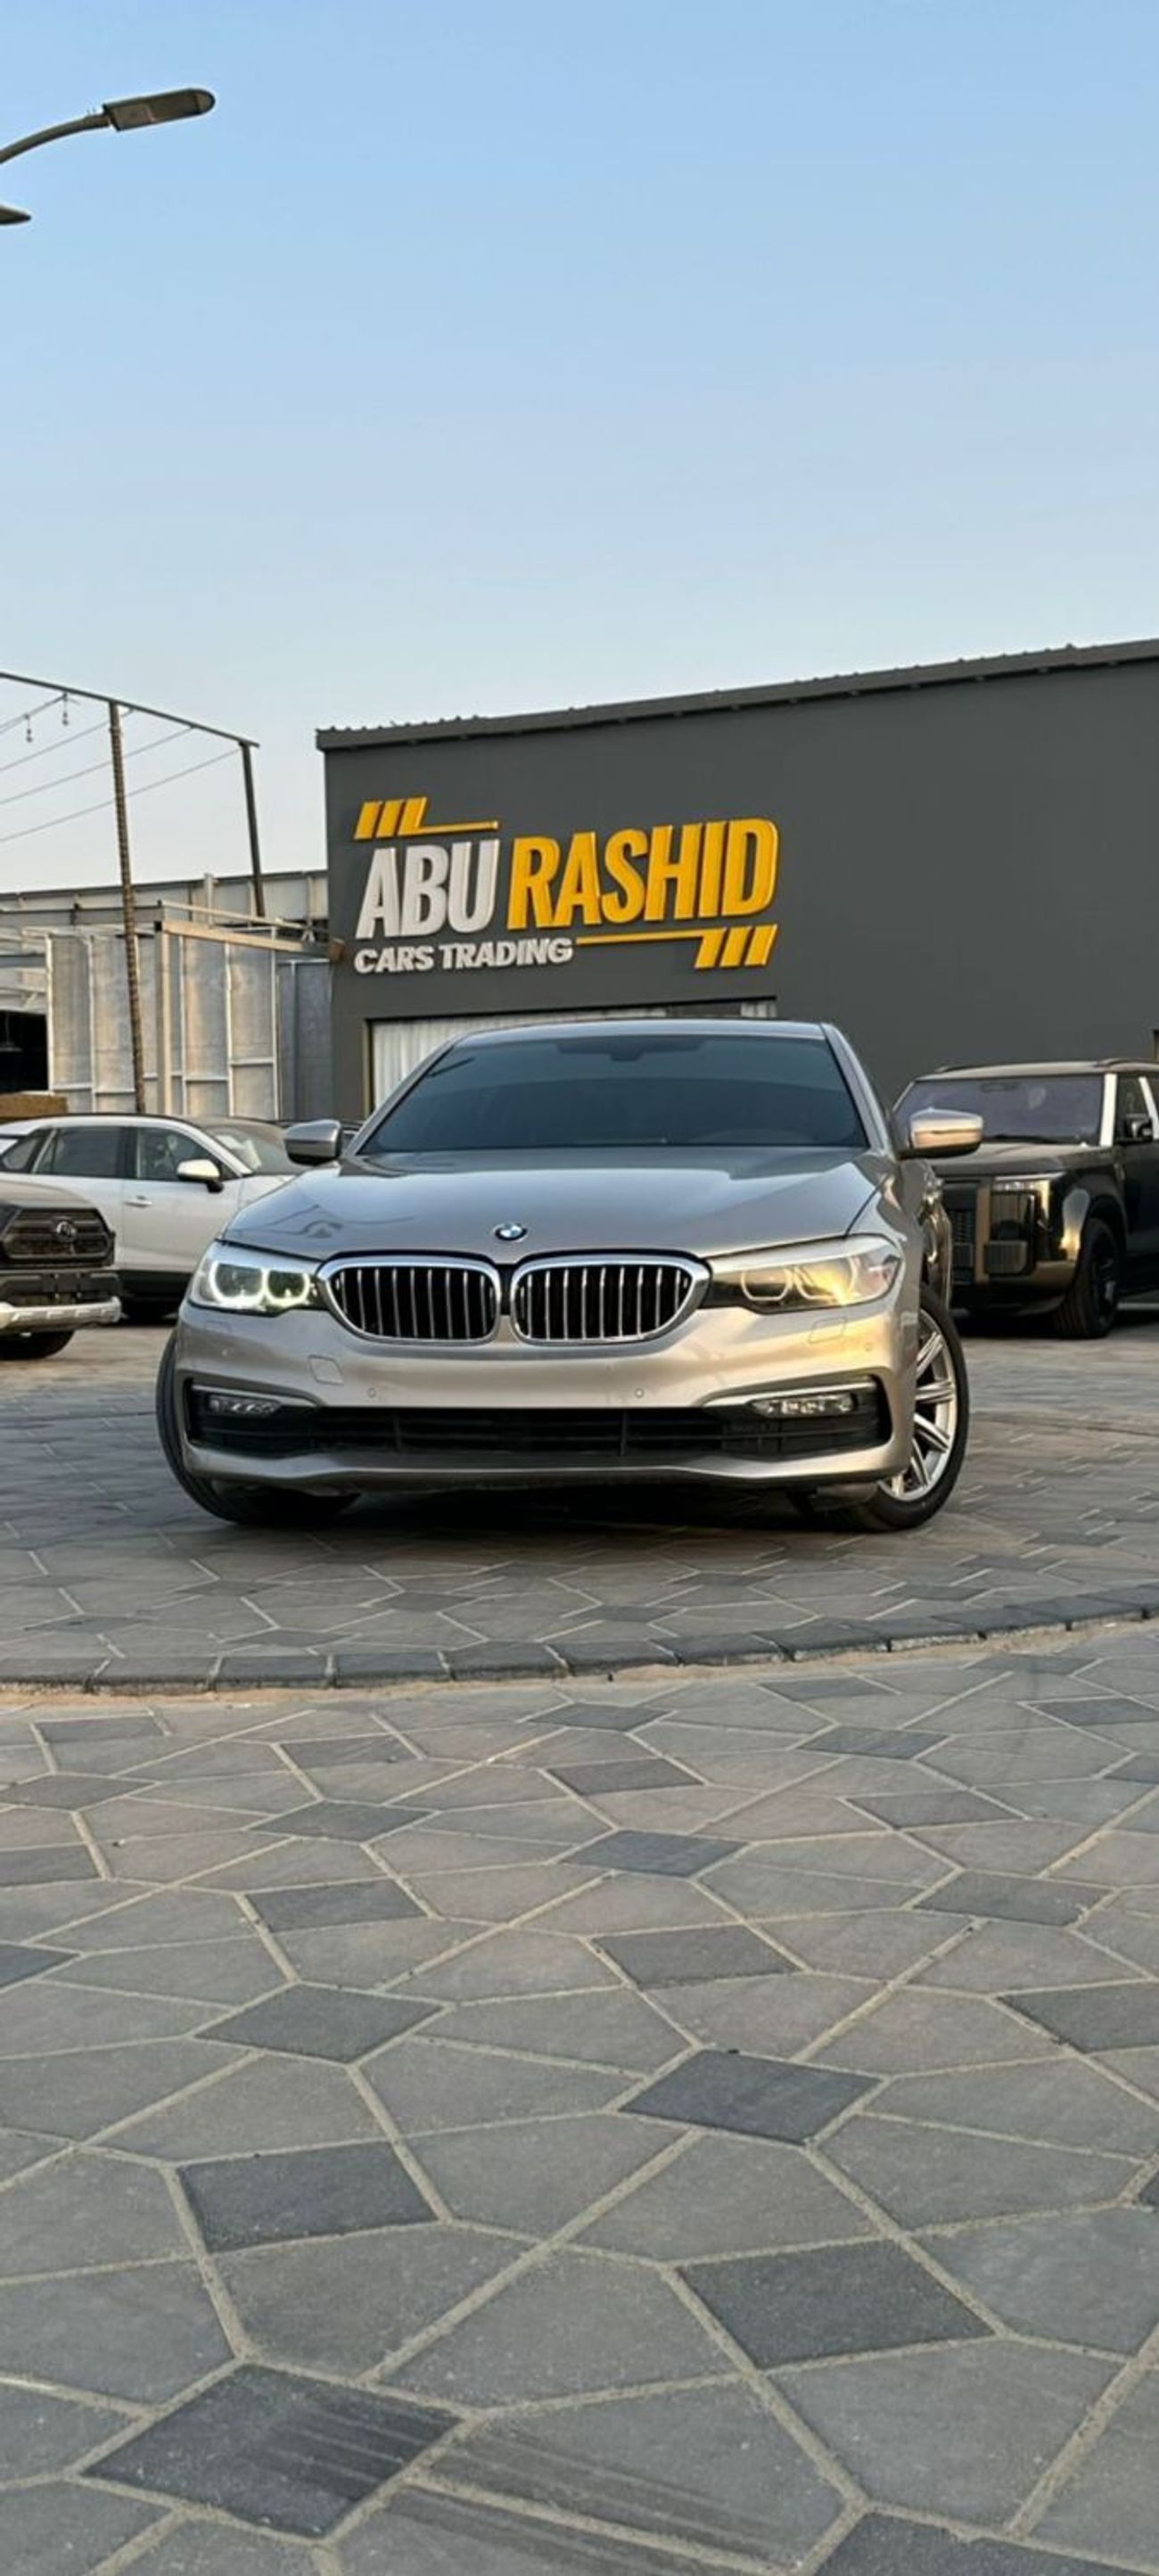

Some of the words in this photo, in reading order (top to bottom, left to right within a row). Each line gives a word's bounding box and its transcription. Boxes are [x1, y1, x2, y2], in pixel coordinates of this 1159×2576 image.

[357, 838, 500, 939] ABU
[506, 817, 778, 930] RASHID
[355, 946, 434, 974] CARS
[438, 936, 573, 969] TRADING
